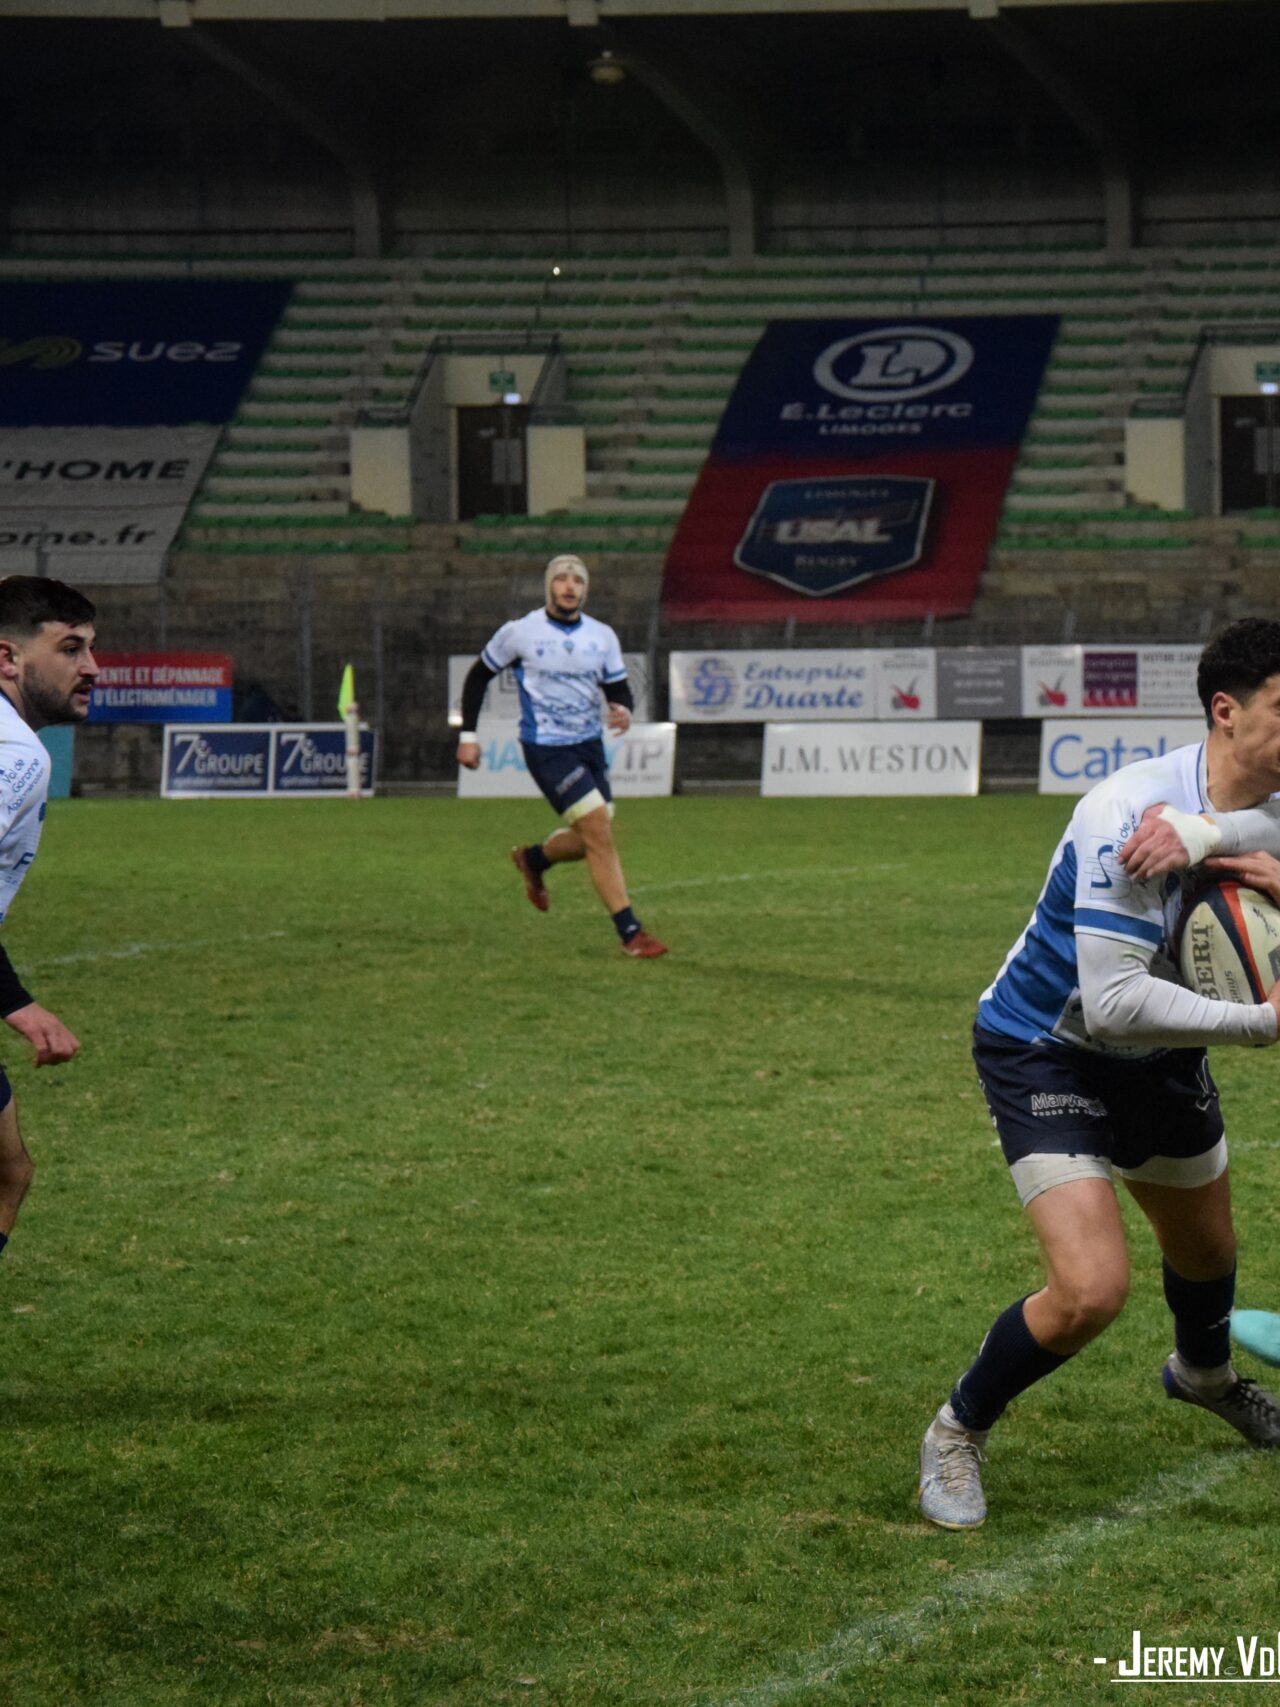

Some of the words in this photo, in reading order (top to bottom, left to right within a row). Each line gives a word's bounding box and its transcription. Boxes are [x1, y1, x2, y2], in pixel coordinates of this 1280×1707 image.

[818, 422, 922, 436] LIMOGES
[775, 518, 893, 544] USAL
[744, 662, 866, 684] Entreprise
[744, 683, 865, 710] Duarte
[194, 753, 265, 775] GROUPE
[301, 752, 369, 774] GROUE
[771, 745, 829, 774] J.M.
[839, 744, 971, 773] WESTON
[1120, 822, 1131, 838] de
